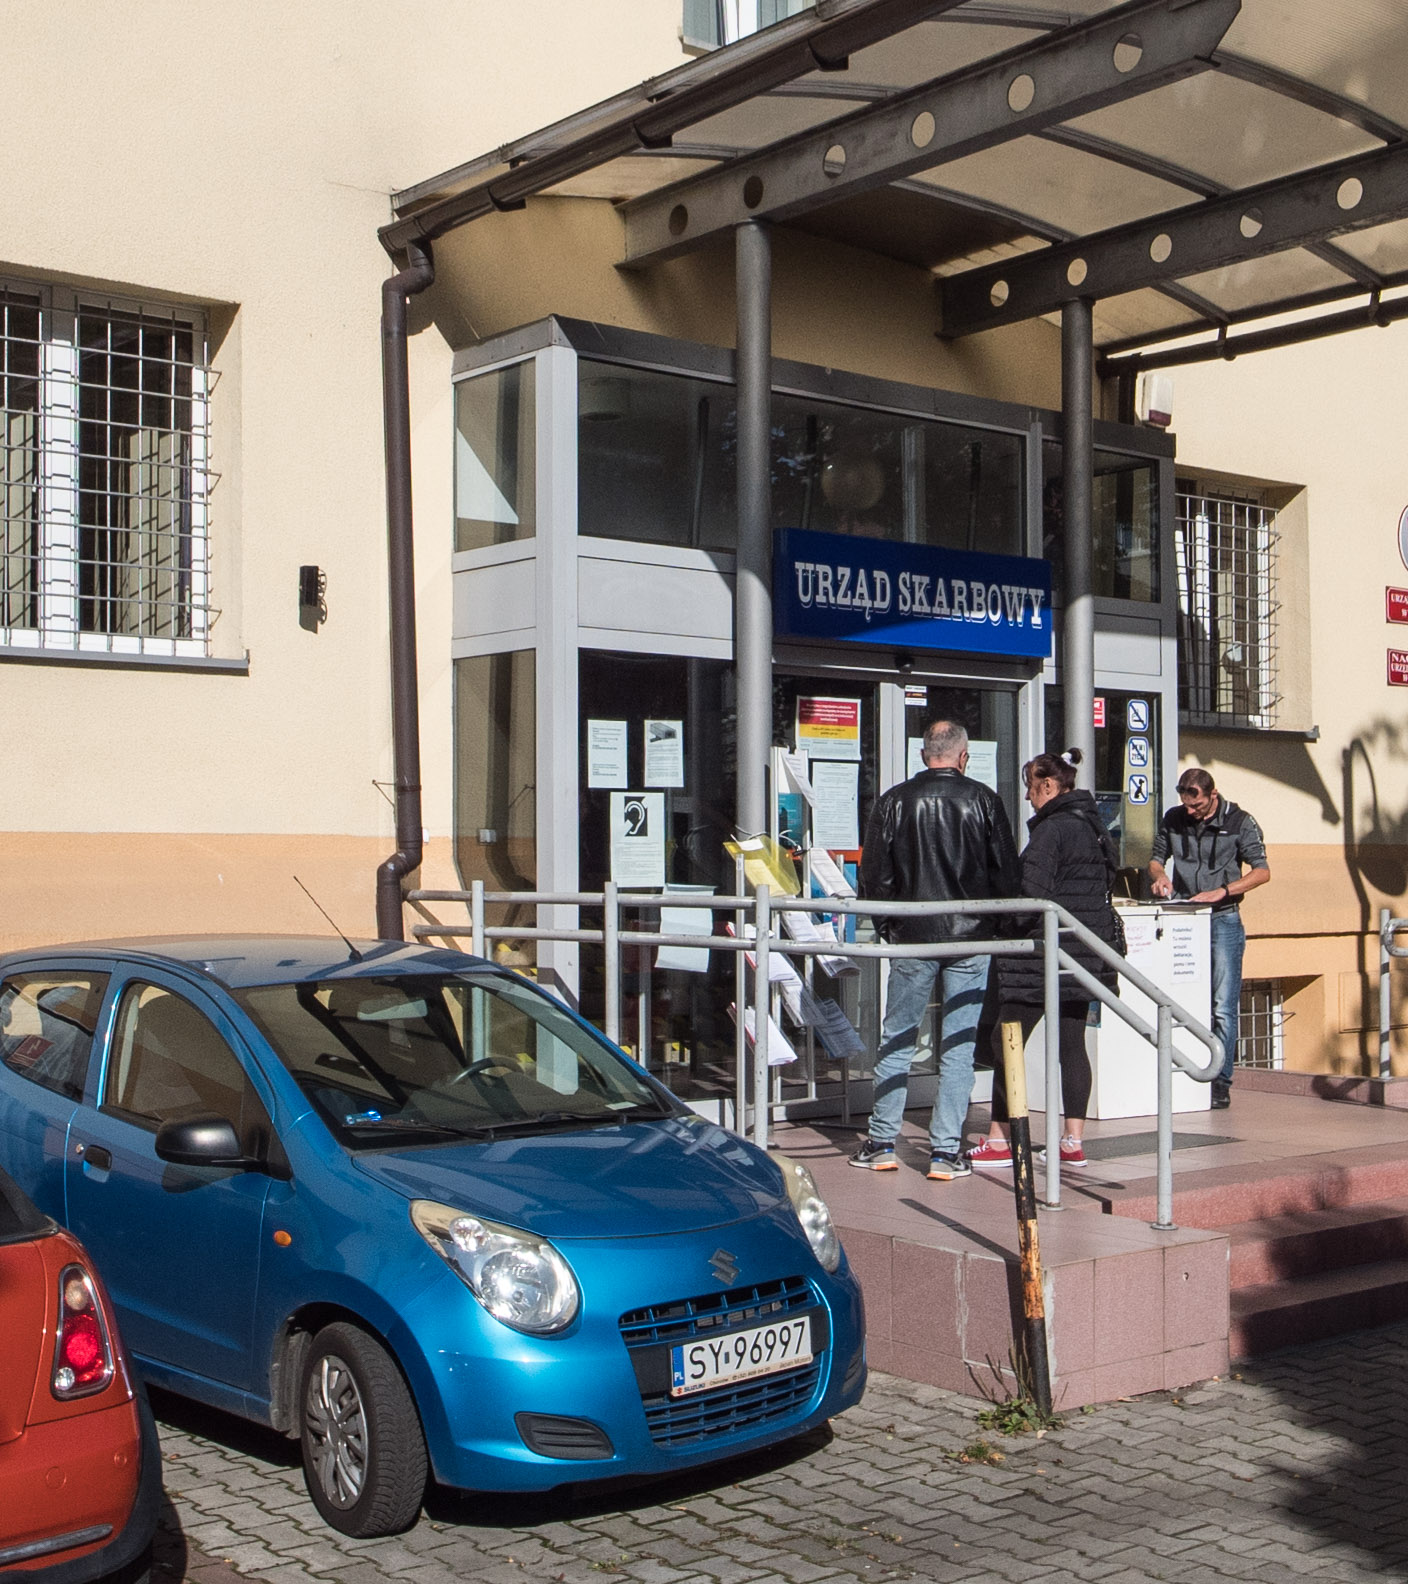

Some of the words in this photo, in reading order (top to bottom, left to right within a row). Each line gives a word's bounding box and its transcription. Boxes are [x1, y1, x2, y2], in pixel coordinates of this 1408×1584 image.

[795, 562, 891, 623] URZĄD
[898, 571, 1045, 629] SKARBOWY
[1401, 608, 1408, 617] W
[689, 1340, 724, 1379] SY
[734, 1321, 805, 1370] 96997
[674, 1372, 684, 1382] PL
